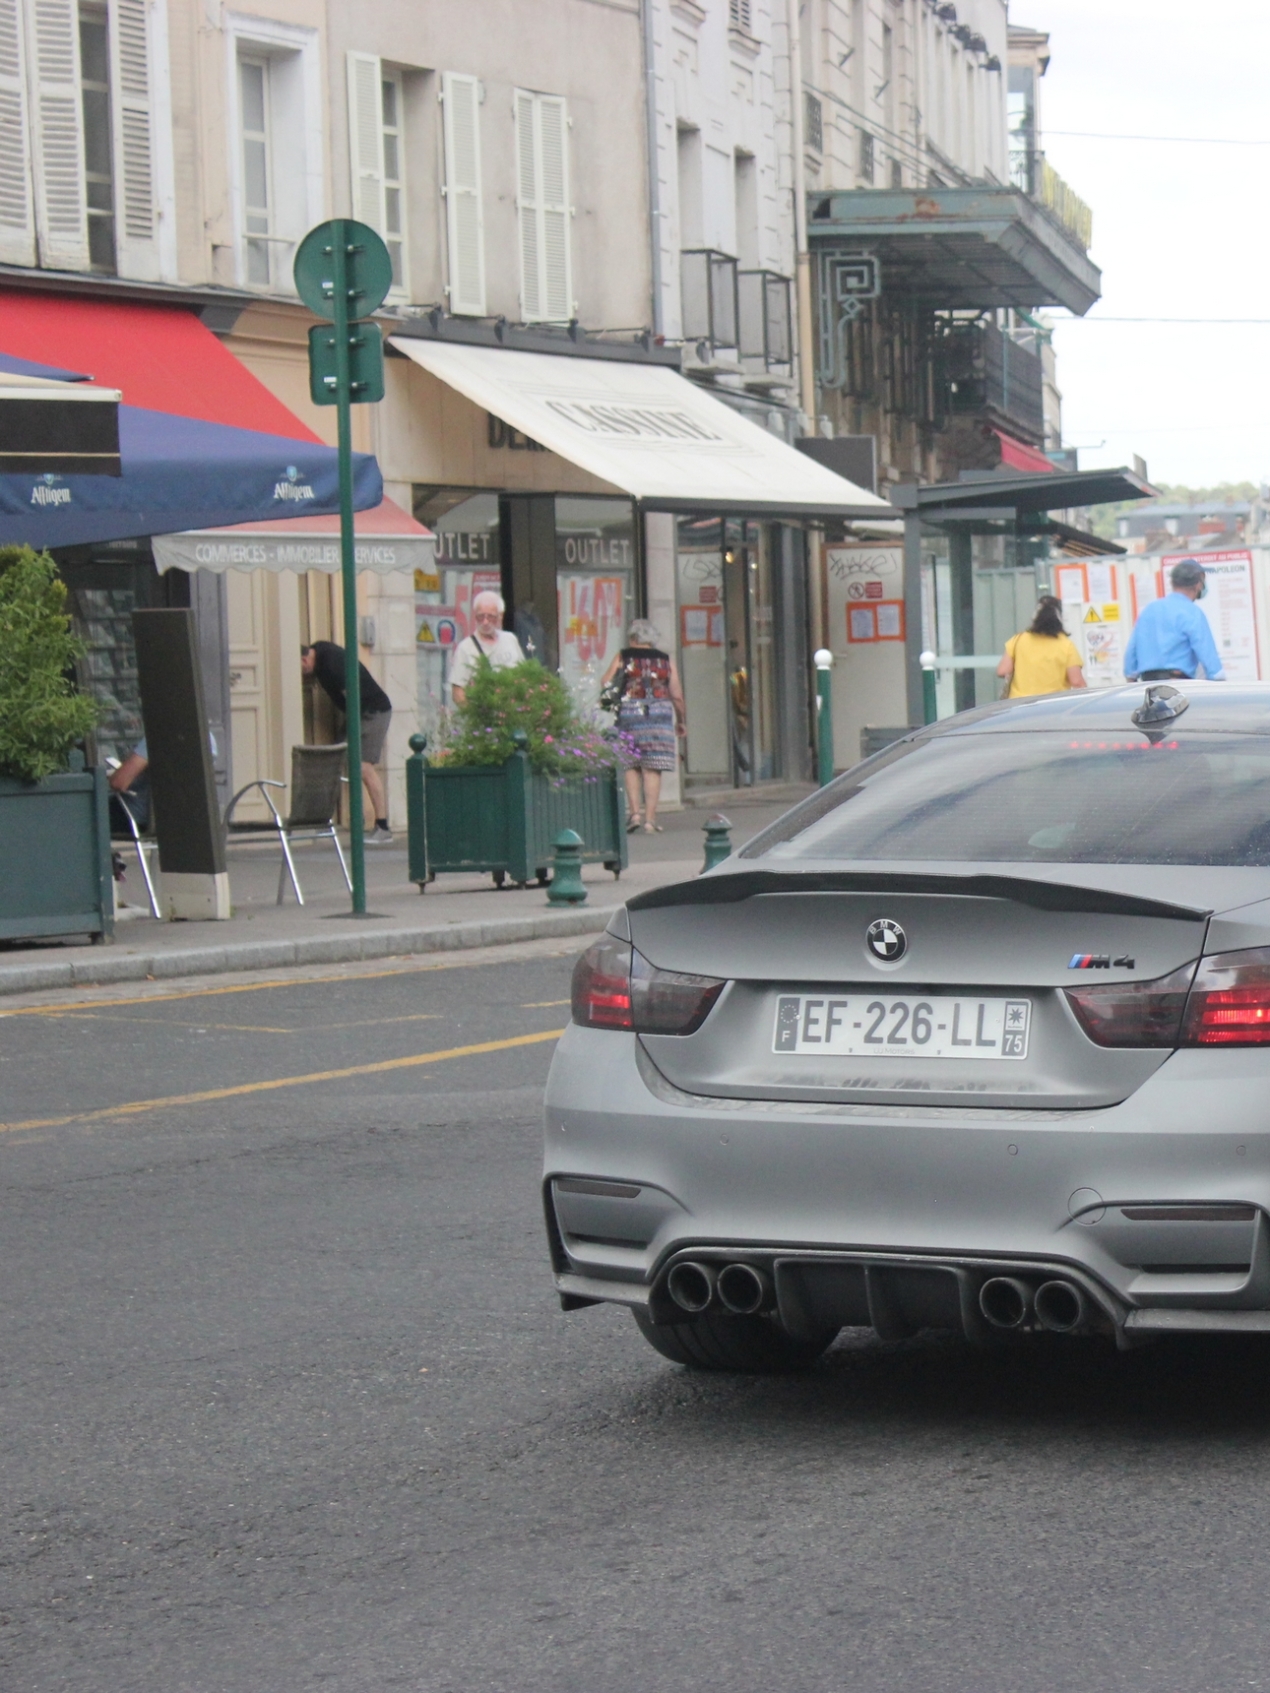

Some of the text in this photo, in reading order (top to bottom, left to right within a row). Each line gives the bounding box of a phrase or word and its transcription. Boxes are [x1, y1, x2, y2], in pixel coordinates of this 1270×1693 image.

[195, 543, 266, 563] COMMERCES
[276, 545, 340, 564] IMMOBILIER
[355, 546, 396, 564] ERVICES
[433, 532, 491, 560] UTLET
[565, 538, 630, 564] OUTLET
[868, 920, 902, 935] BMW
[781, 999, 1024, 1053] F EF-226-LL 75
